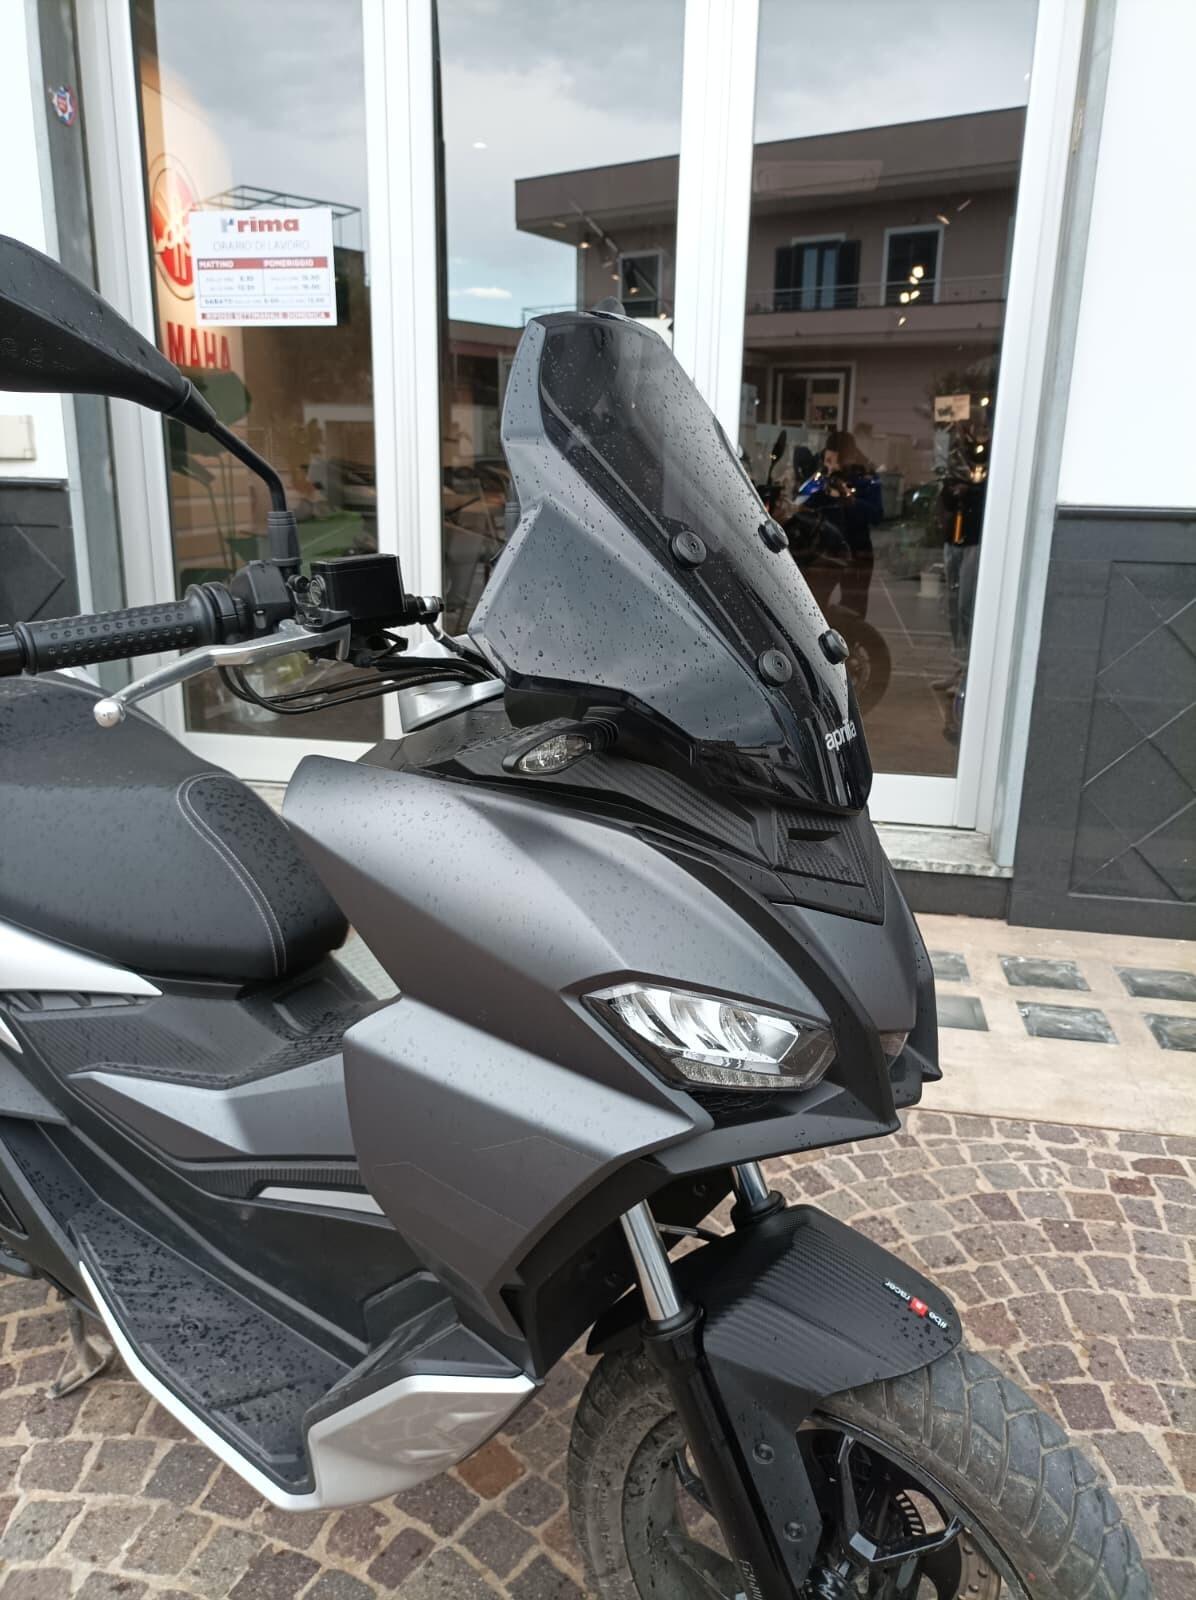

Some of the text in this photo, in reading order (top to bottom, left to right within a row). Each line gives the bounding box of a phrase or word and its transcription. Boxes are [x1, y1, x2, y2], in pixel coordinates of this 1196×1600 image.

[268, 239, 310, 250] LAVORO
[199, 260, 234, 269] MATTINO
[824, 719, 857, 751] aprilia
[884, 1279, 911, 1300] racer
